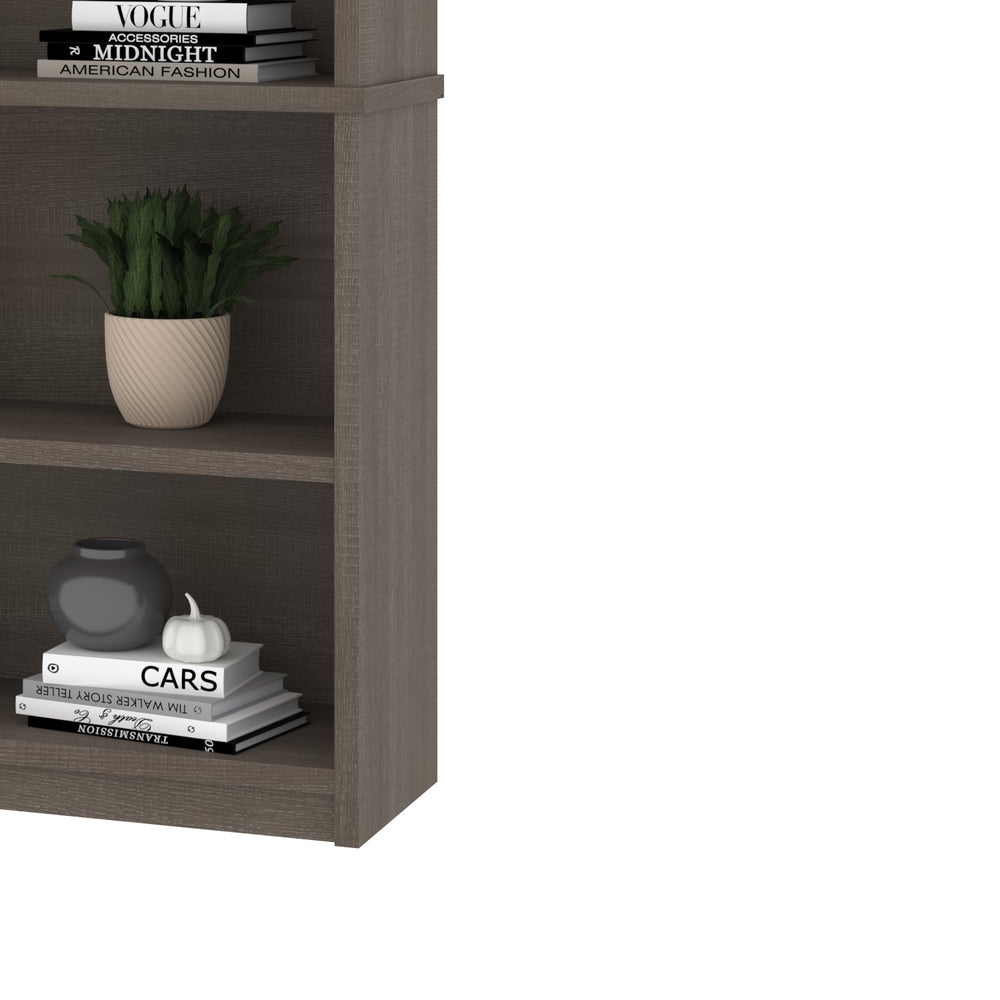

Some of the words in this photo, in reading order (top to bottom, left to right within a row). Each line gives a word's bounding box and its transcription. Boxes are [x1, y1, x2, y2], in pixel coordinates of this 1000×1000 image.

[116, 4, 201, 29] VOGUE
[108, 32, 199, 44] ACCESSORIES
[93, 44, 217, 63] MIDNIGHT
[60, 64, 155, 77] AMERICAN
[161, 66, 241, 79] FASHION
[141, 665, 218, 692] CARS
[36, 684, 73, 700] TELLER
[75, 690, 114, 705] STORY
[116, 696, 165, 711] WALKER
[168, 702, 188, 714] TIM
[113, 713, 153, 732] Death
[78, 723, 169, 745] TRANSMISSION
[204, 739, 215, 752] 50
